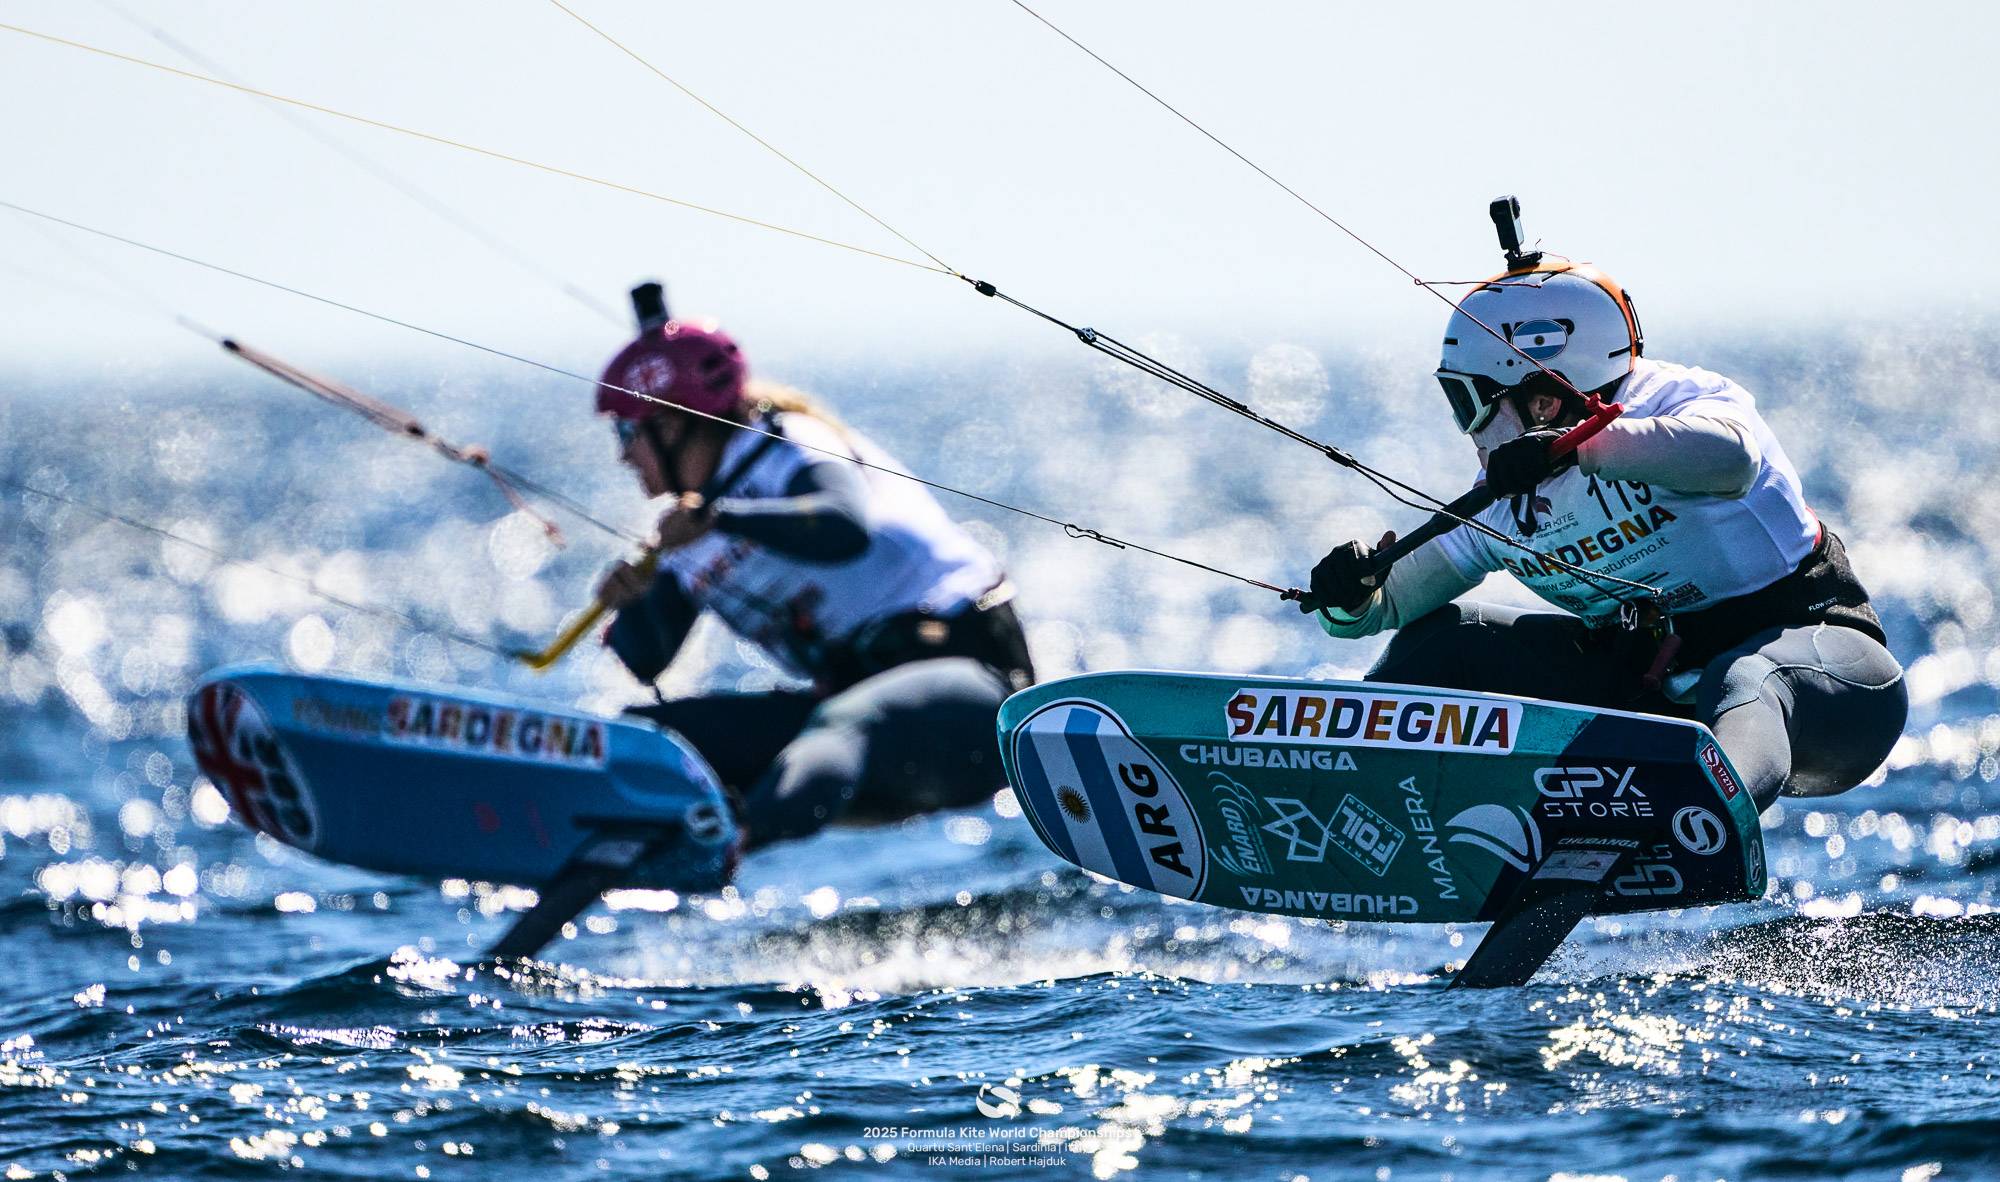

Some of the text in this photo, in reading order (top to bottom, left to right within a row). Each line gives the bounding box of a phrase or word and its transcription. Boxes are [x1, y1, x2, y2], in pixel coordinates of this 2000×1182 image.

[1553, 511, 1575, 527] KITE
[1586, 473, 1653, 521] 119
[1502, 505, 1678, 578] SARDEGNA
[386, 698, 602, 761] SARDEGNA
[1228, 694, 1510, 749] SARDEGNA
[1179, 744, 1359, 771] CHUBANGA
[1533, 766, 1647, 798] GPX
[1718, 767, 1735, 793] 17270
[1117, 762, 1195, 880] ARG
[1341, 805, 1397, 864] FOIL
[1543, 802, 1654, 818] STORE
[1222, 806, 1262, 873] ENARD
[1399, 775, 1459, 900] MANERA
[1239, 886, 1419, 916] CHUBANGA
